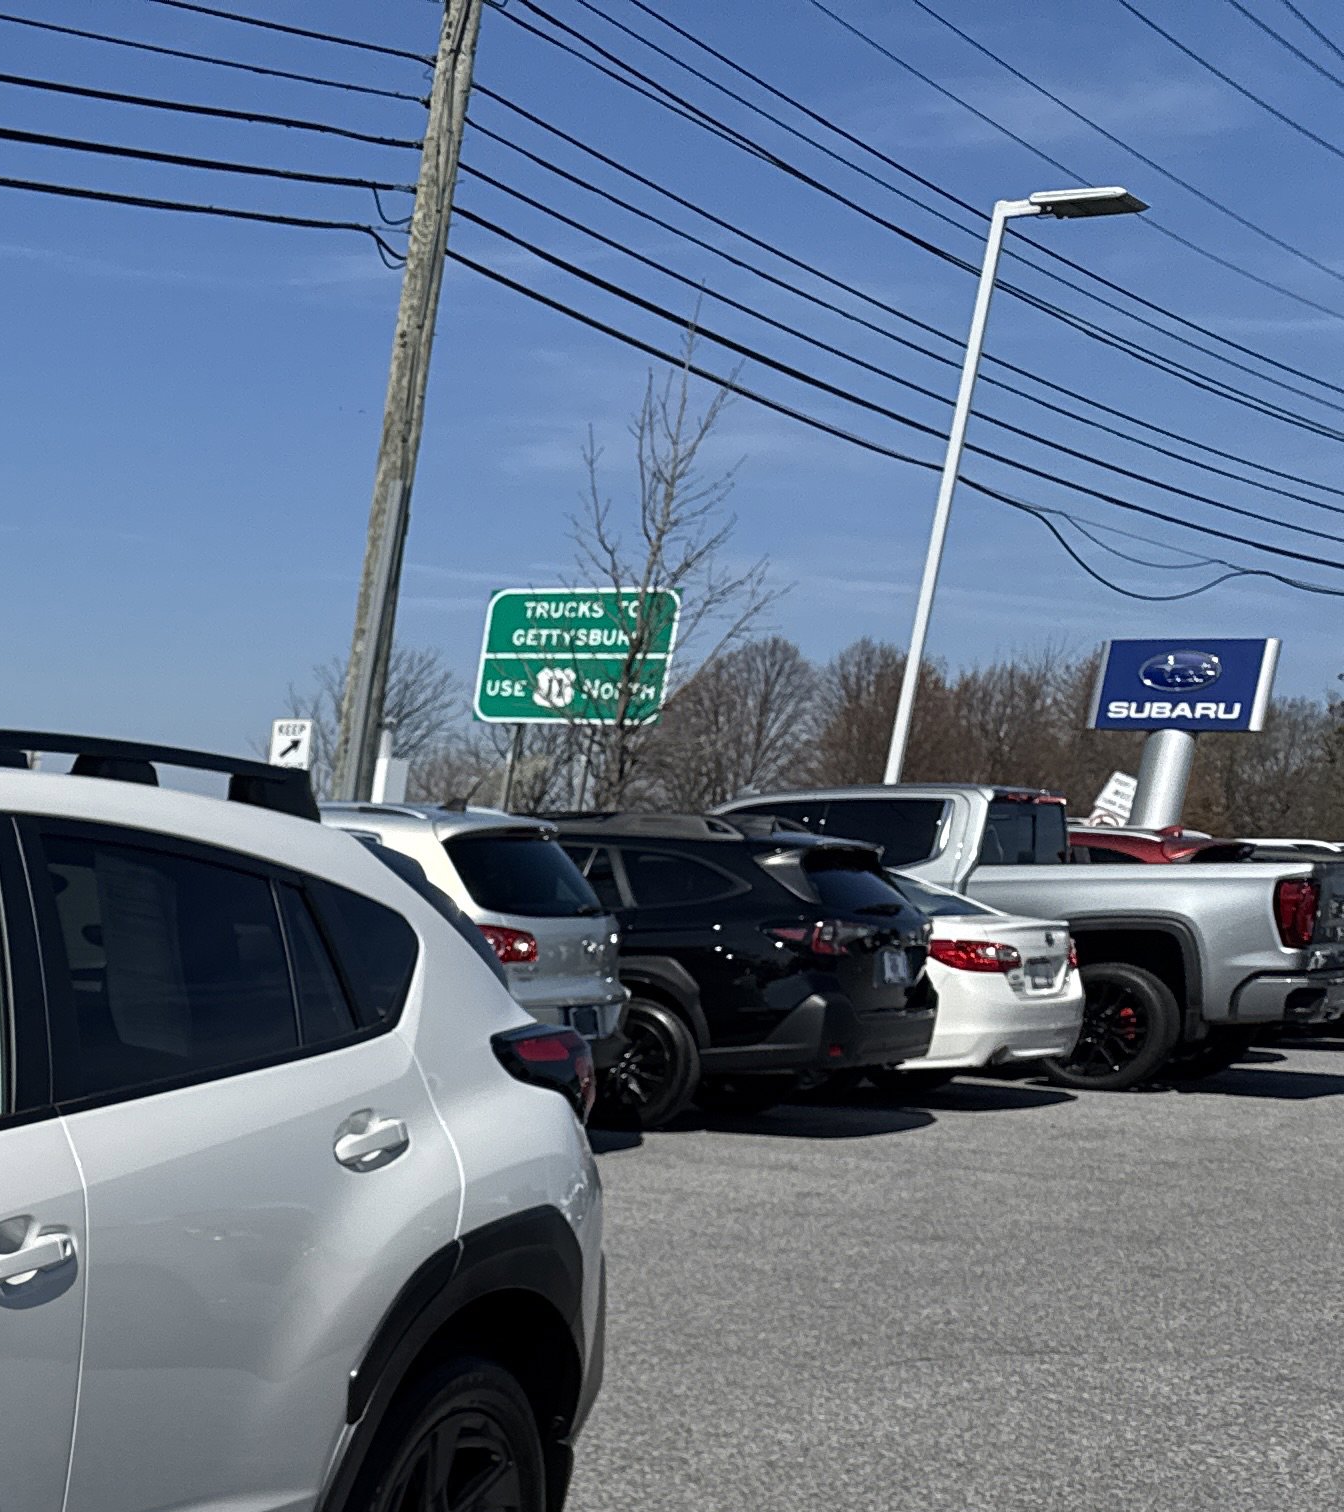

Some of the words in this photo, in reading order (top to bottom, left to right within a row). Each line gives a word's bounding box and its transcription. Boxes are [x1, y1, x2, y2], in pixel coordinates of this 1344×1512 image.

[524, 600, 604, 619] TRUCKS
[512, 628, 643, 647] GETTYSBUR
[486, 679, 527, 698] USE
[1106, 701, 1242, 720] SUBARU
